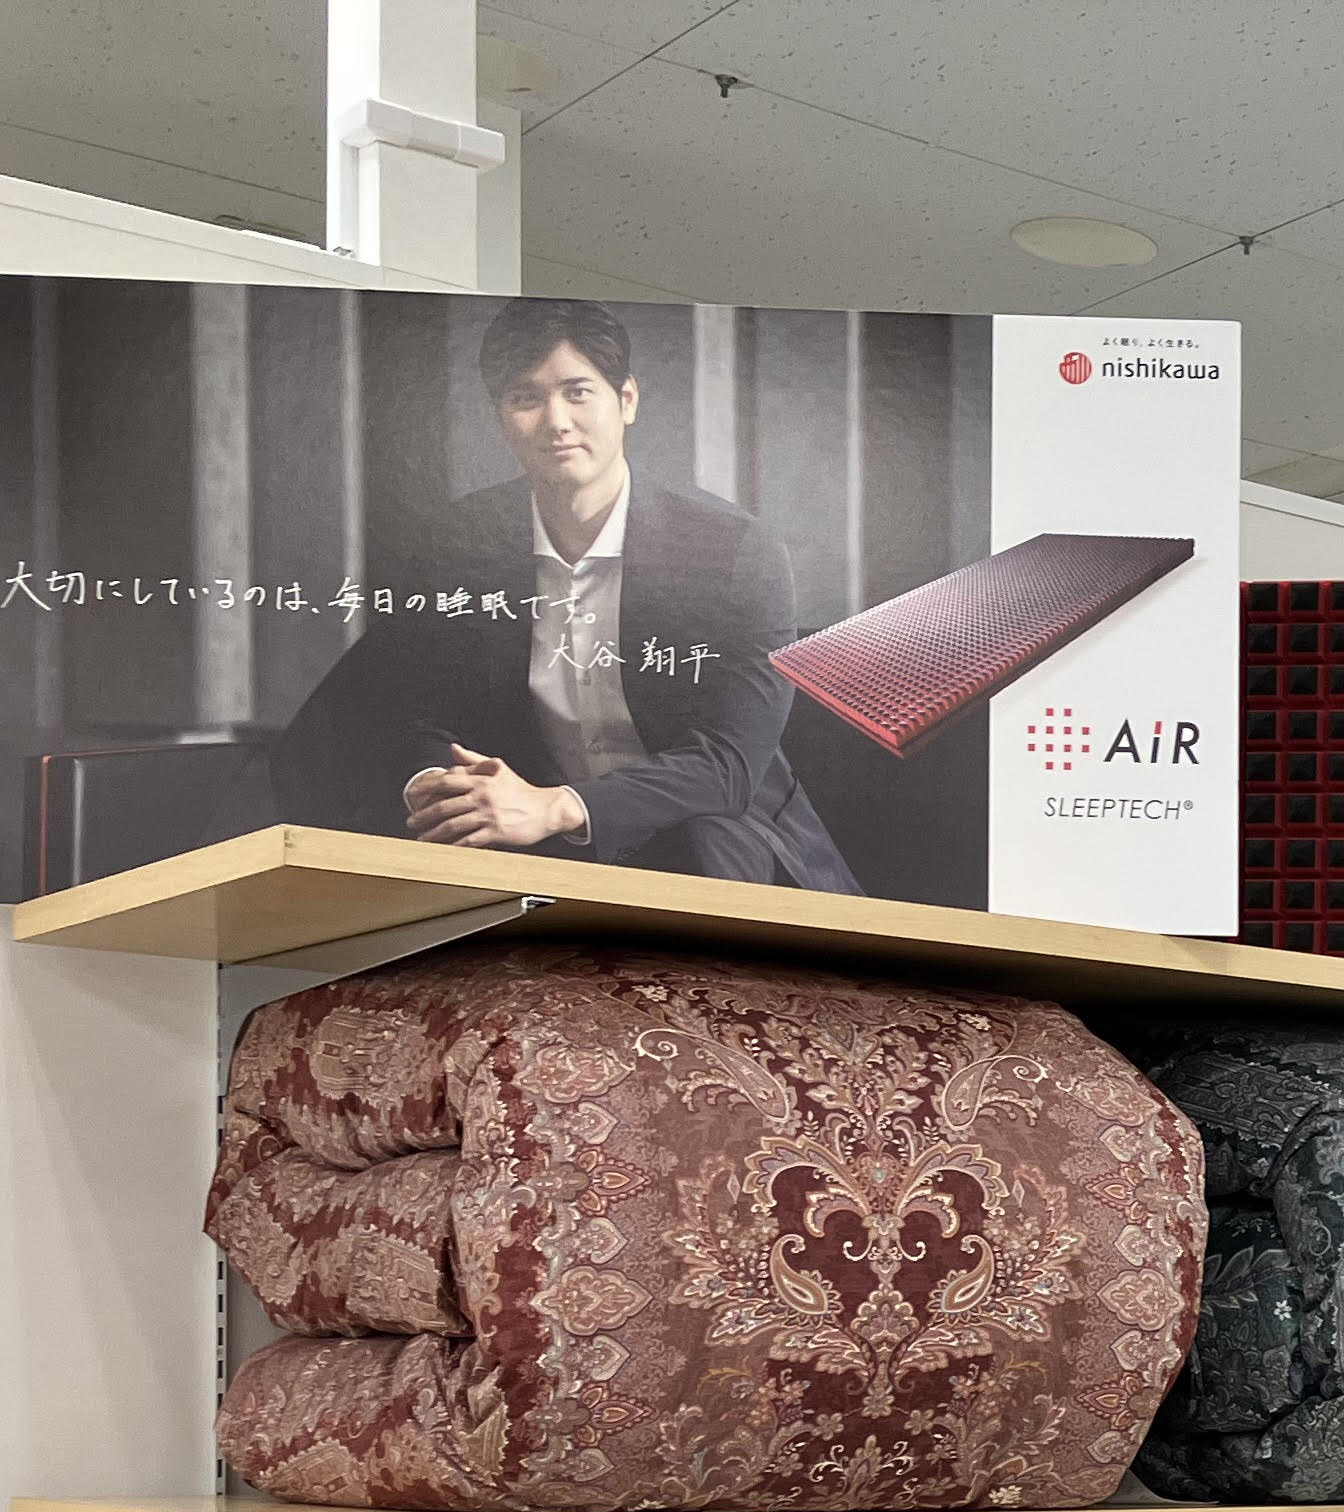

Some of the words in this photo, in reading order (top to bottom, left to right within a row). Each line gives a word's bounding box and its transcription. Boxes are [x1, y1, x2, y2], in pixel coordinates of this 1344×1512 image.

[1102, 357, 1220, 380] nishikawa
[4, 561, 597, 624] 大切にしているのは、毎日の睡眠です。
